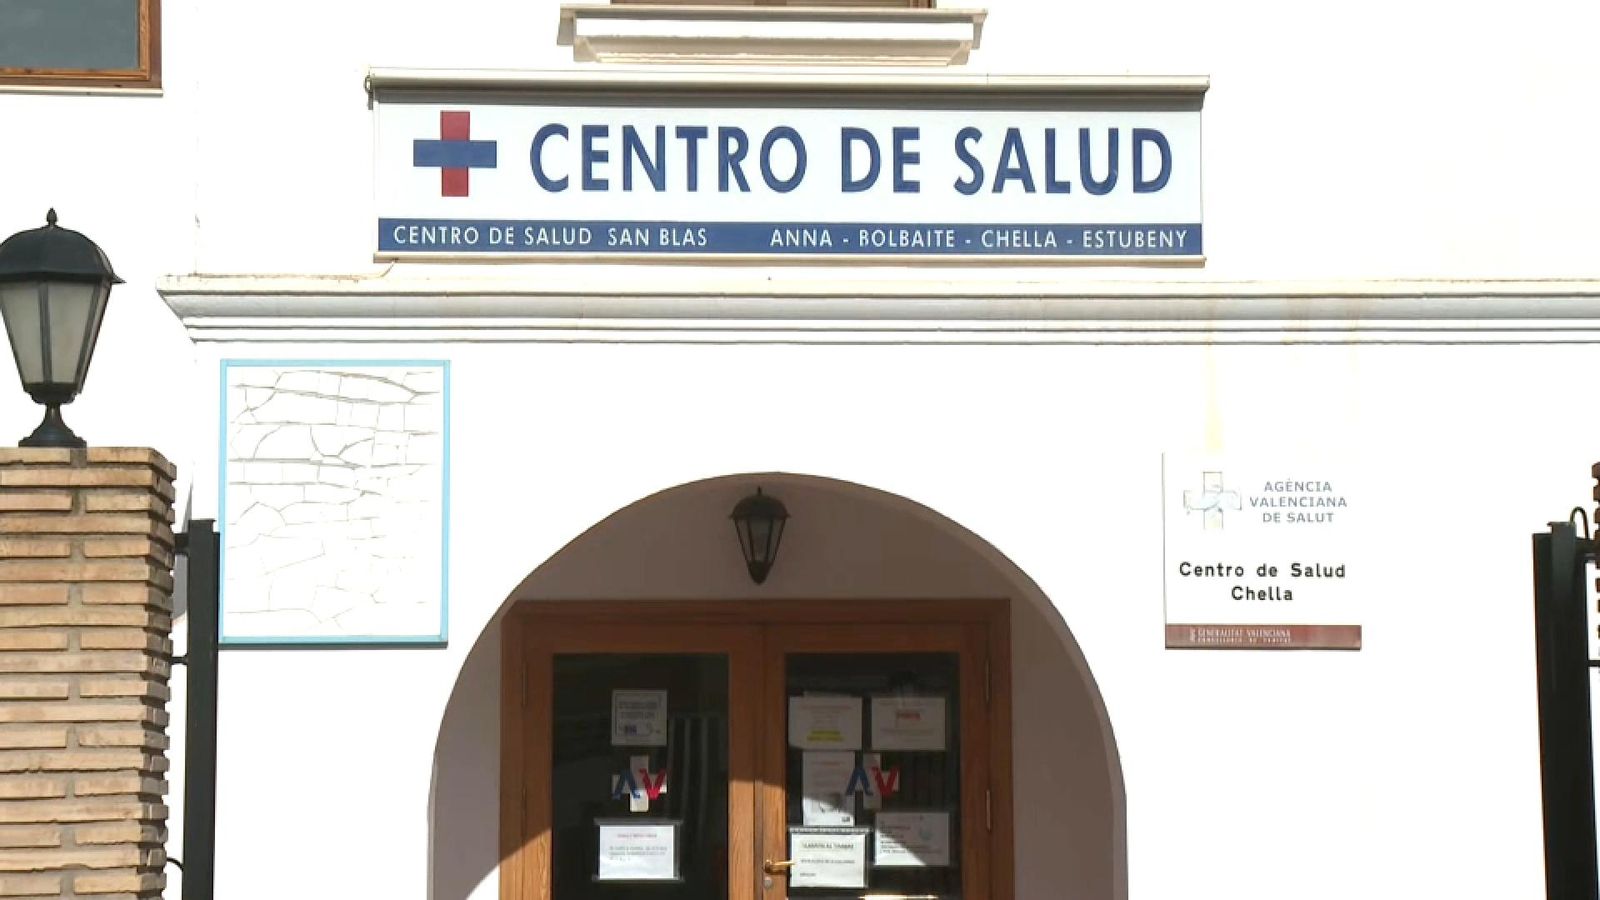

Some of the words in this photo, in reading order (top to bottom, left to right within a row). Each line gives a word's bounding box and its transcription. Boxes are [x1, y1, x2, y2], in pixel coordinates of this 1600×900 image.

[529, 122, 808, 193] CENTRO
[840, 126, 921, 194] DE
[953, 126, 1173, 196] SALUD
[393, 225, 479, 246] CENTRO
[489, 226, 515, 246] DE
[524, 226, 592, 246] SALUD
[607, 227, 649, 247] SAN
[659, 228, 707, 247] BLAS
[769, 229, 833, 248] ANNA
[981, 229, 1058, 248] CHELLA
[1082, 229, 1188, 249] ESTUBENY
[1249, 496, 1348, 508] VALENCIANA
[1262, 512, 1281, 524] DE
[1286, 512, 1334, 524] SALUT
[1179, 561, 1245, 578] Centro
[1256, 562, 1278, 578] de
[1290, 562, 1346, 579] Salud
[1231, 585, 1294, 601] Chella
